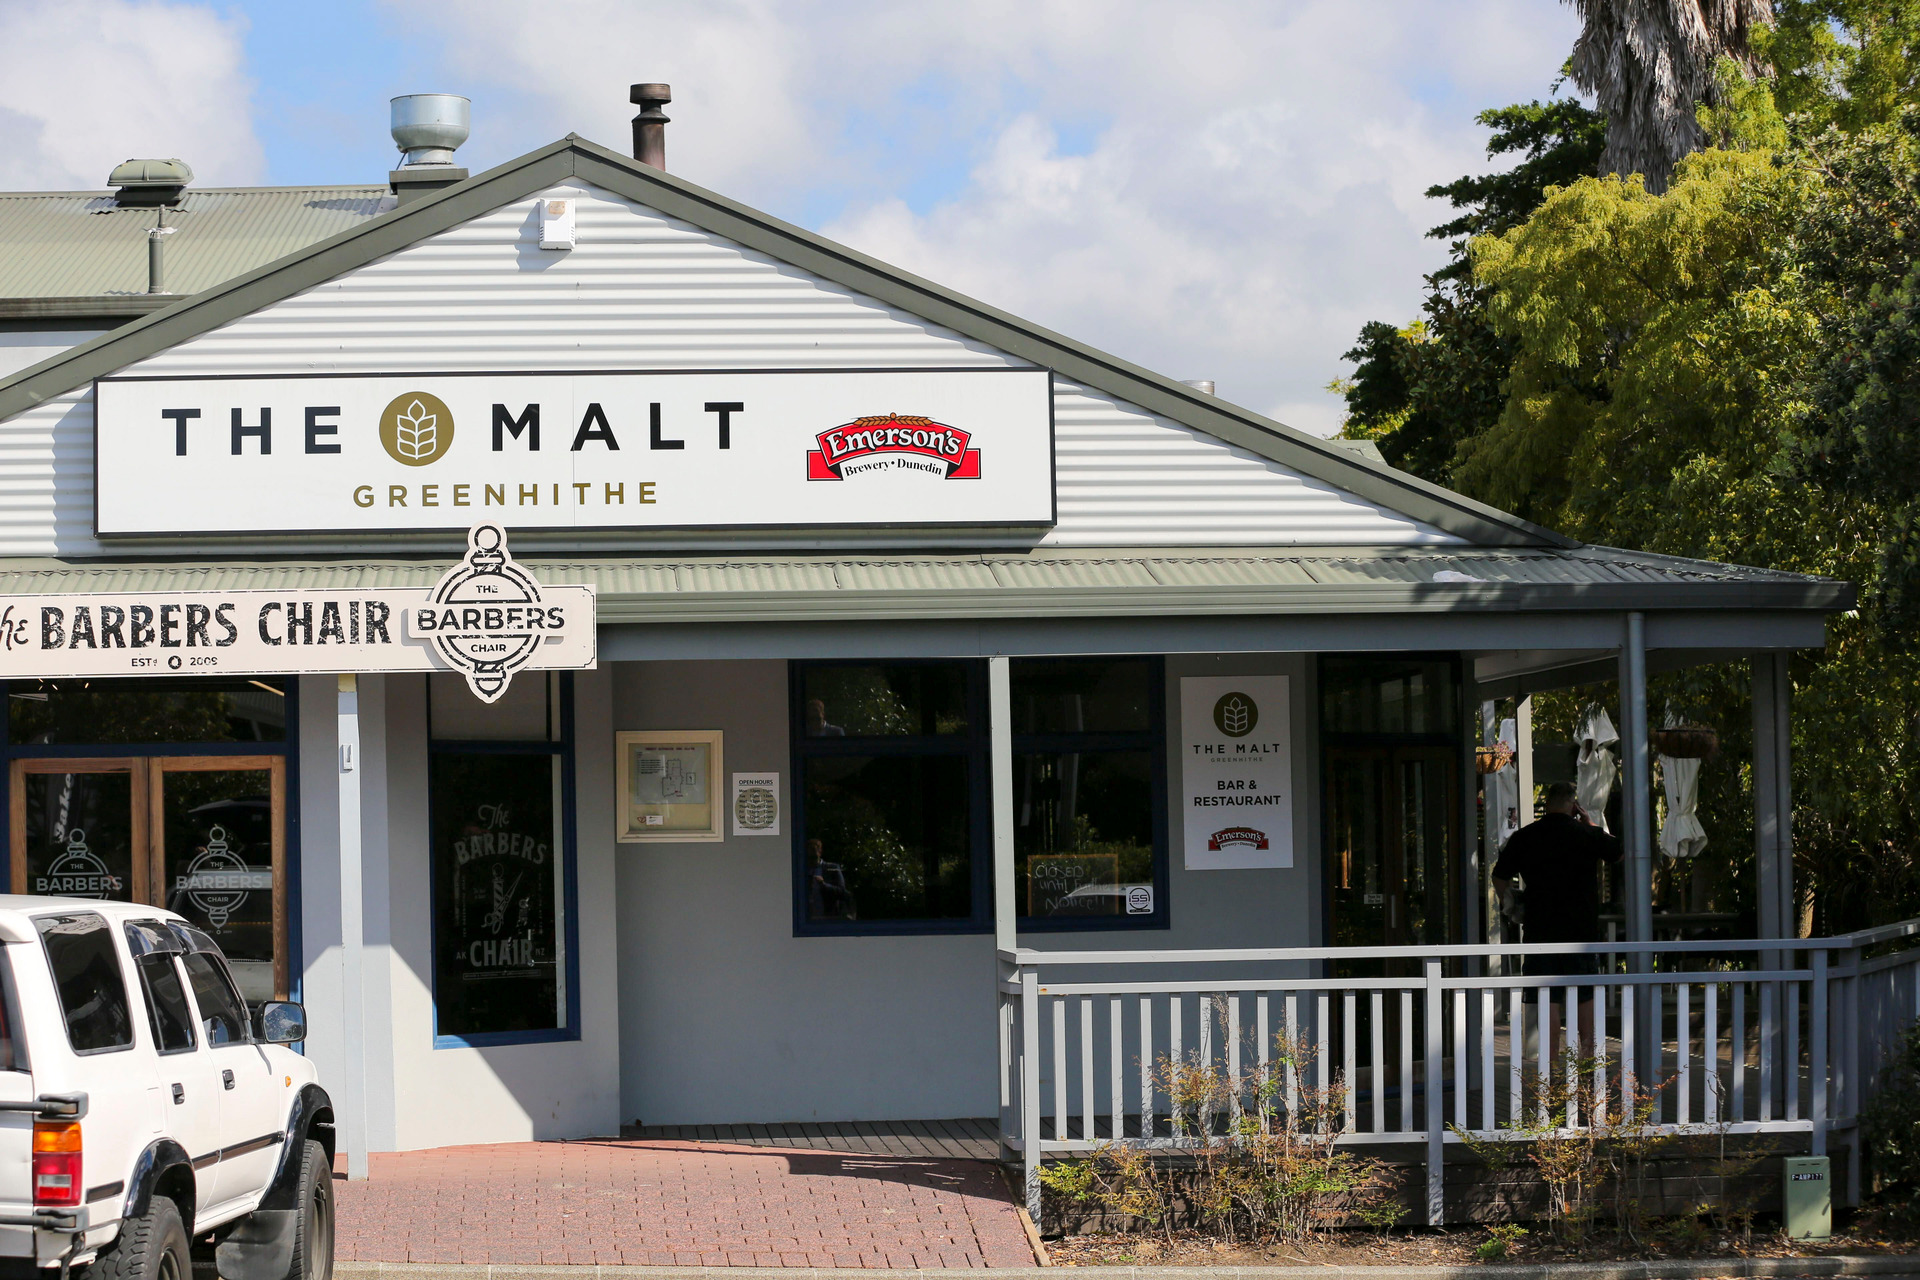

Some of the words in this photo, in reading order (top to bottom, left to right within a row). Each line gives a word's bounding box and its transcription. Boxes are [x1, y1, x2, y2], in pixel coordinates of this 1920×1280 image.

[162, 406, 341, 457] THE
[491, 401, 744, 452] MALT
[825, 427, 962, 459] Emerson's
[845, 460, 890, 477] Brewery
[897, 458, 942, 476] Dunedin
[353, 481, 657, 508] GREENHITHE
[475, 585, 499, 593] THE
[40, 601, 237, 650] BARBERS
[258, 600, 392, 645] CHAIR
[417, 607, 565, 631] BARBERS
[470, 644, 507, 653] CHAIR
[1193, 744, 1225, 754] THE
[1236, 743, 1280, 754] MALT
[1217, 780, 1245, 790] BAR
[1248, 780, 1257, 790] &
[1194, 795, 1281, 807] RESTAURANT
[477, 803, 510, 830] The
[1215, 831, 1262, 842] Emerson's
[453, 832, 547, 866] BARBERS
[36, 876, 123, 892] BARBERS
[176, 875, 263, 889] BARBERS
[470, 938, 534, 968] CHAIR
